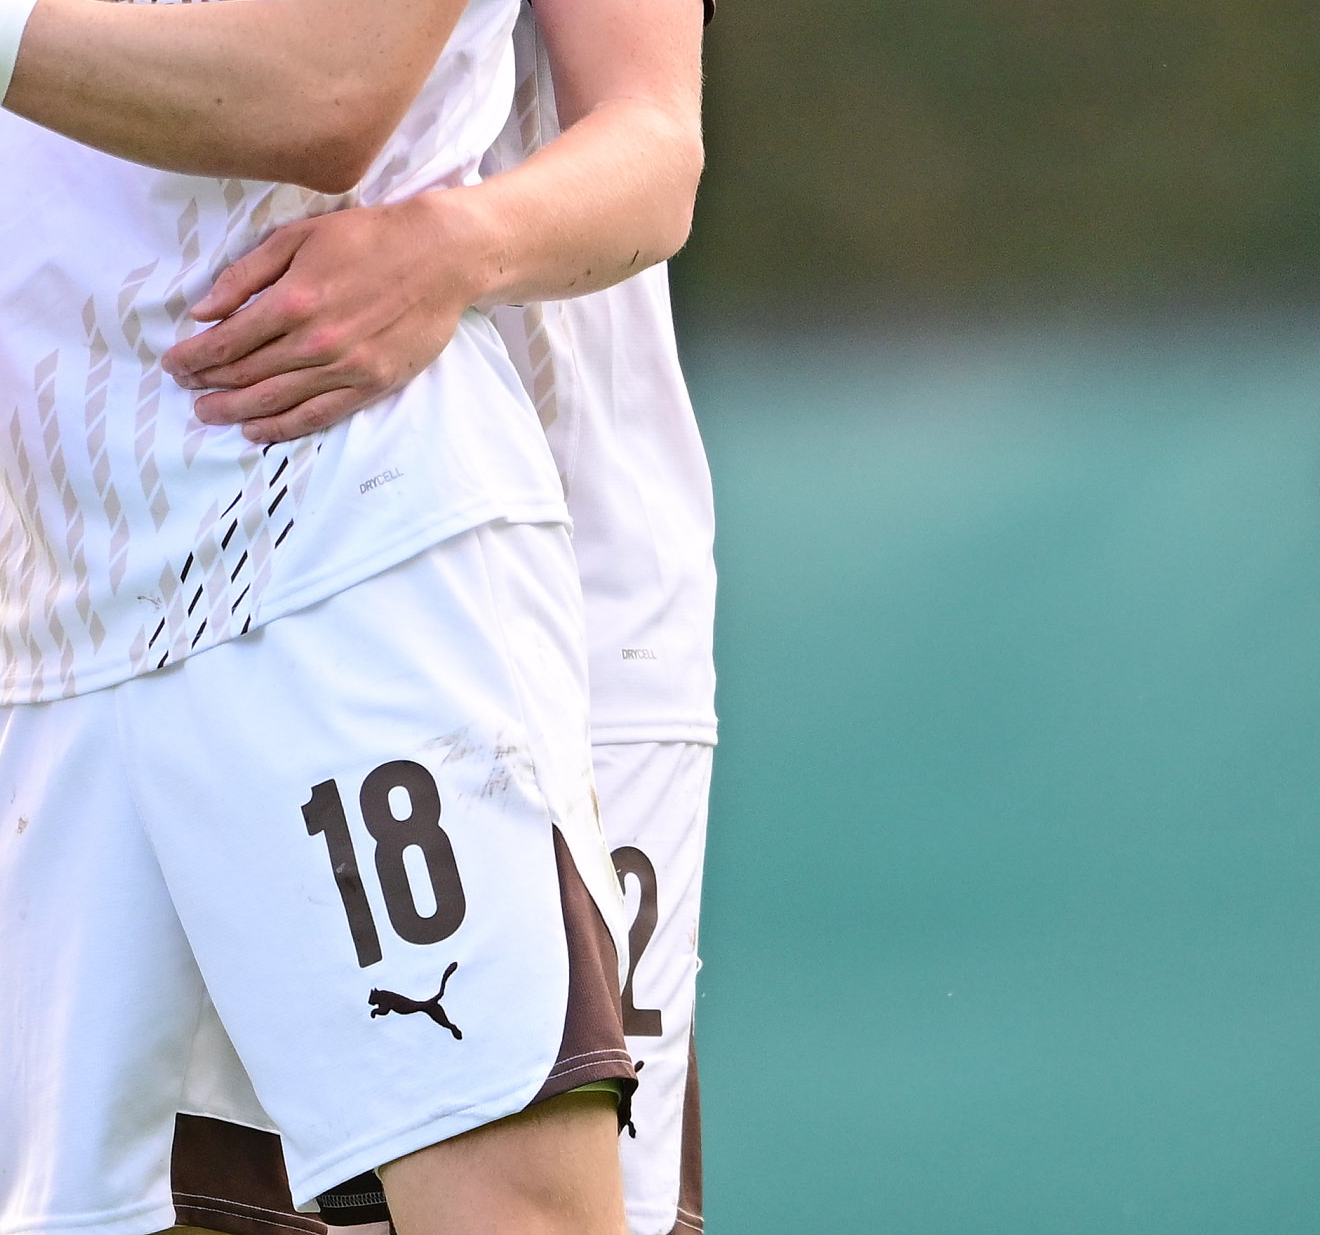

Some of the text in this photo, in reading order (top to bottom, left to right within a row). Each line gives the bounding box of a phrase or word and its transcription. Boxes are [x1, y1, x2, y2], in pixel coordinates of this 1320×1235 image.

[359, 467, 405, 495] DRYCELL
[621, 648, 657, 660] DRYCELL
[301, 759, 467, 969] 18
